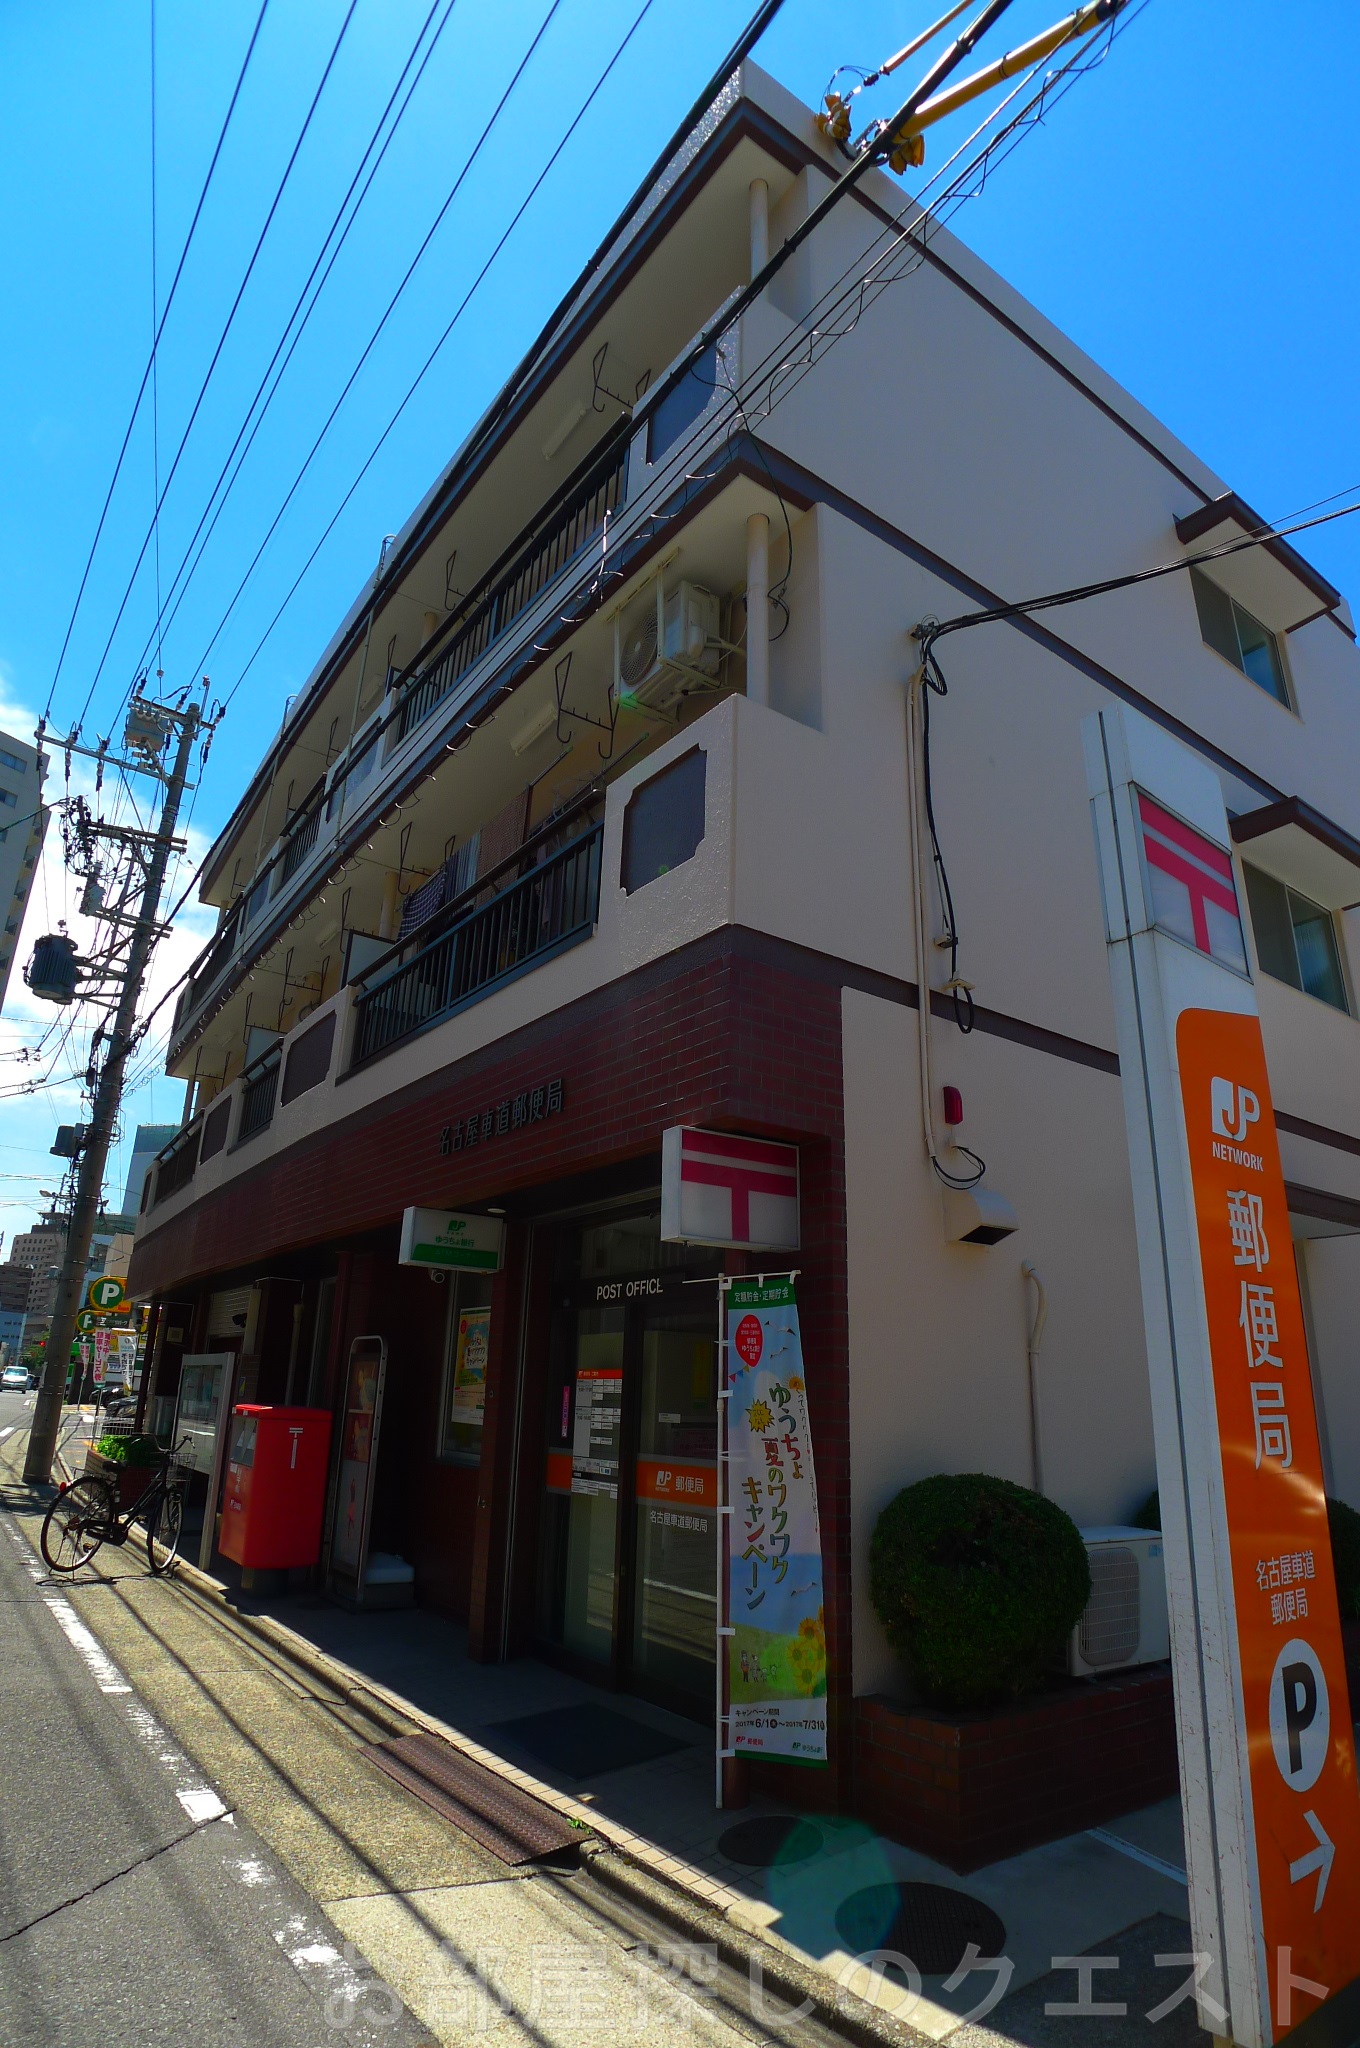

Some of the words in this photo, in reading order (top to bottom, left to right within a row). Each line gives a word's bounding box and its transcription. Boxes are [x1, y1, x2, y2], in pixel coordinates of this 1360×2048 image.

[439, 1077, 563, 1156] 名古屋車道郵便局
[1211, 1140, 1264, 1173] NETWORK
[100, 1283, 120, 1305] P
[596, 1282, 623, 1301] POST
[625, 1277, 664, 1297] OFFICE
[1226, 1189, 1294, 1470] 郵便局
[675, 1475, 704, 1495] 郵便局
[650, 1509, 708, 1534] 名古屋車道郵便局
[761, 1437, 790, 1585] 夏のワクワク
[741, 1476, 769, 1611] キャンペーン
[1255, 1549, 1316, 1592] 名古屋車道
[1270, 1587, 1310, 1626] 郵便局
[1281, 1661, 1318, 1774] P
